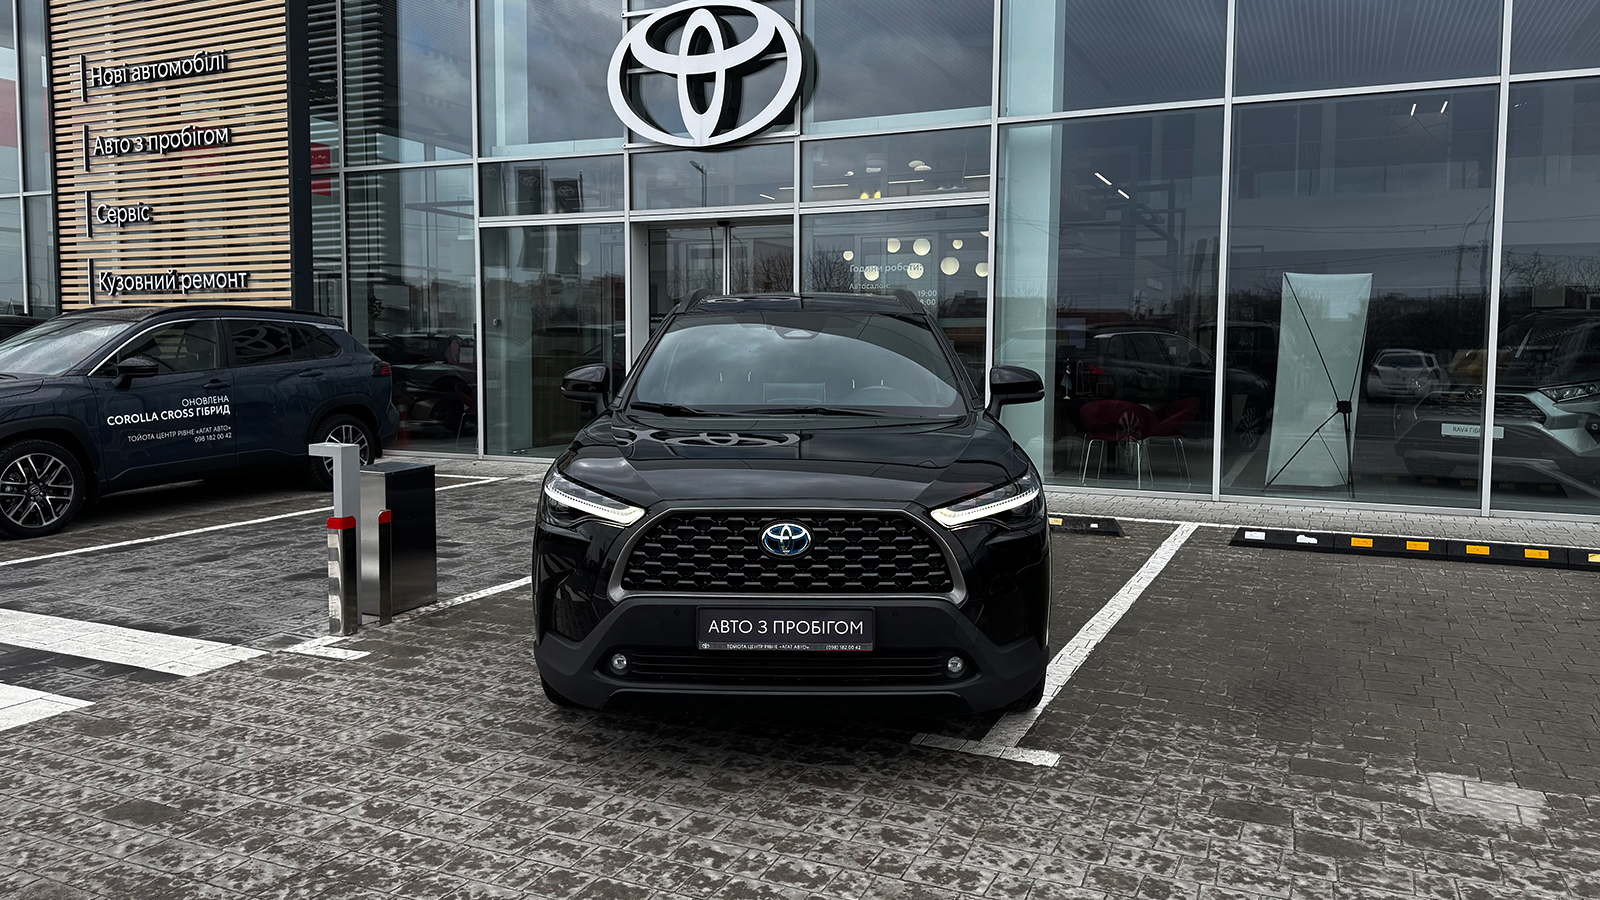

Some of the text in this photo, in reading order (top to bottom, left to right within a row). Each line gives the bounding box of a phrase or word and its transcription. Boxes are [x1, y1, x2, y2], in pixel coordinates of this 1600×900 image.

[91, 49, 226, 87] Нові автомобілі
[93, 125, 229, 156] Авто з пробігом
[96, 201, 150, 228] Сервіс
[850, 264, 883, 274] Години
[99, 269, 247, 296] Кузовний ремонт
[917, 298, 937, 306] 8:00
[181, 395, 230, 407] ОНОВЛЕНА
[106, 404, 231, 426] COROLLA CROSS ГІБРИД
[127, 434, 155, 443] ТОЙОТА
[156, 430, 177, 440] ЦЕНТР
[177, 428, 195, 437] РІВНЕ
[194, 435, 206, 443] 098
[708, 619, 864, 635] АВТО З ПРОБІГОМ
